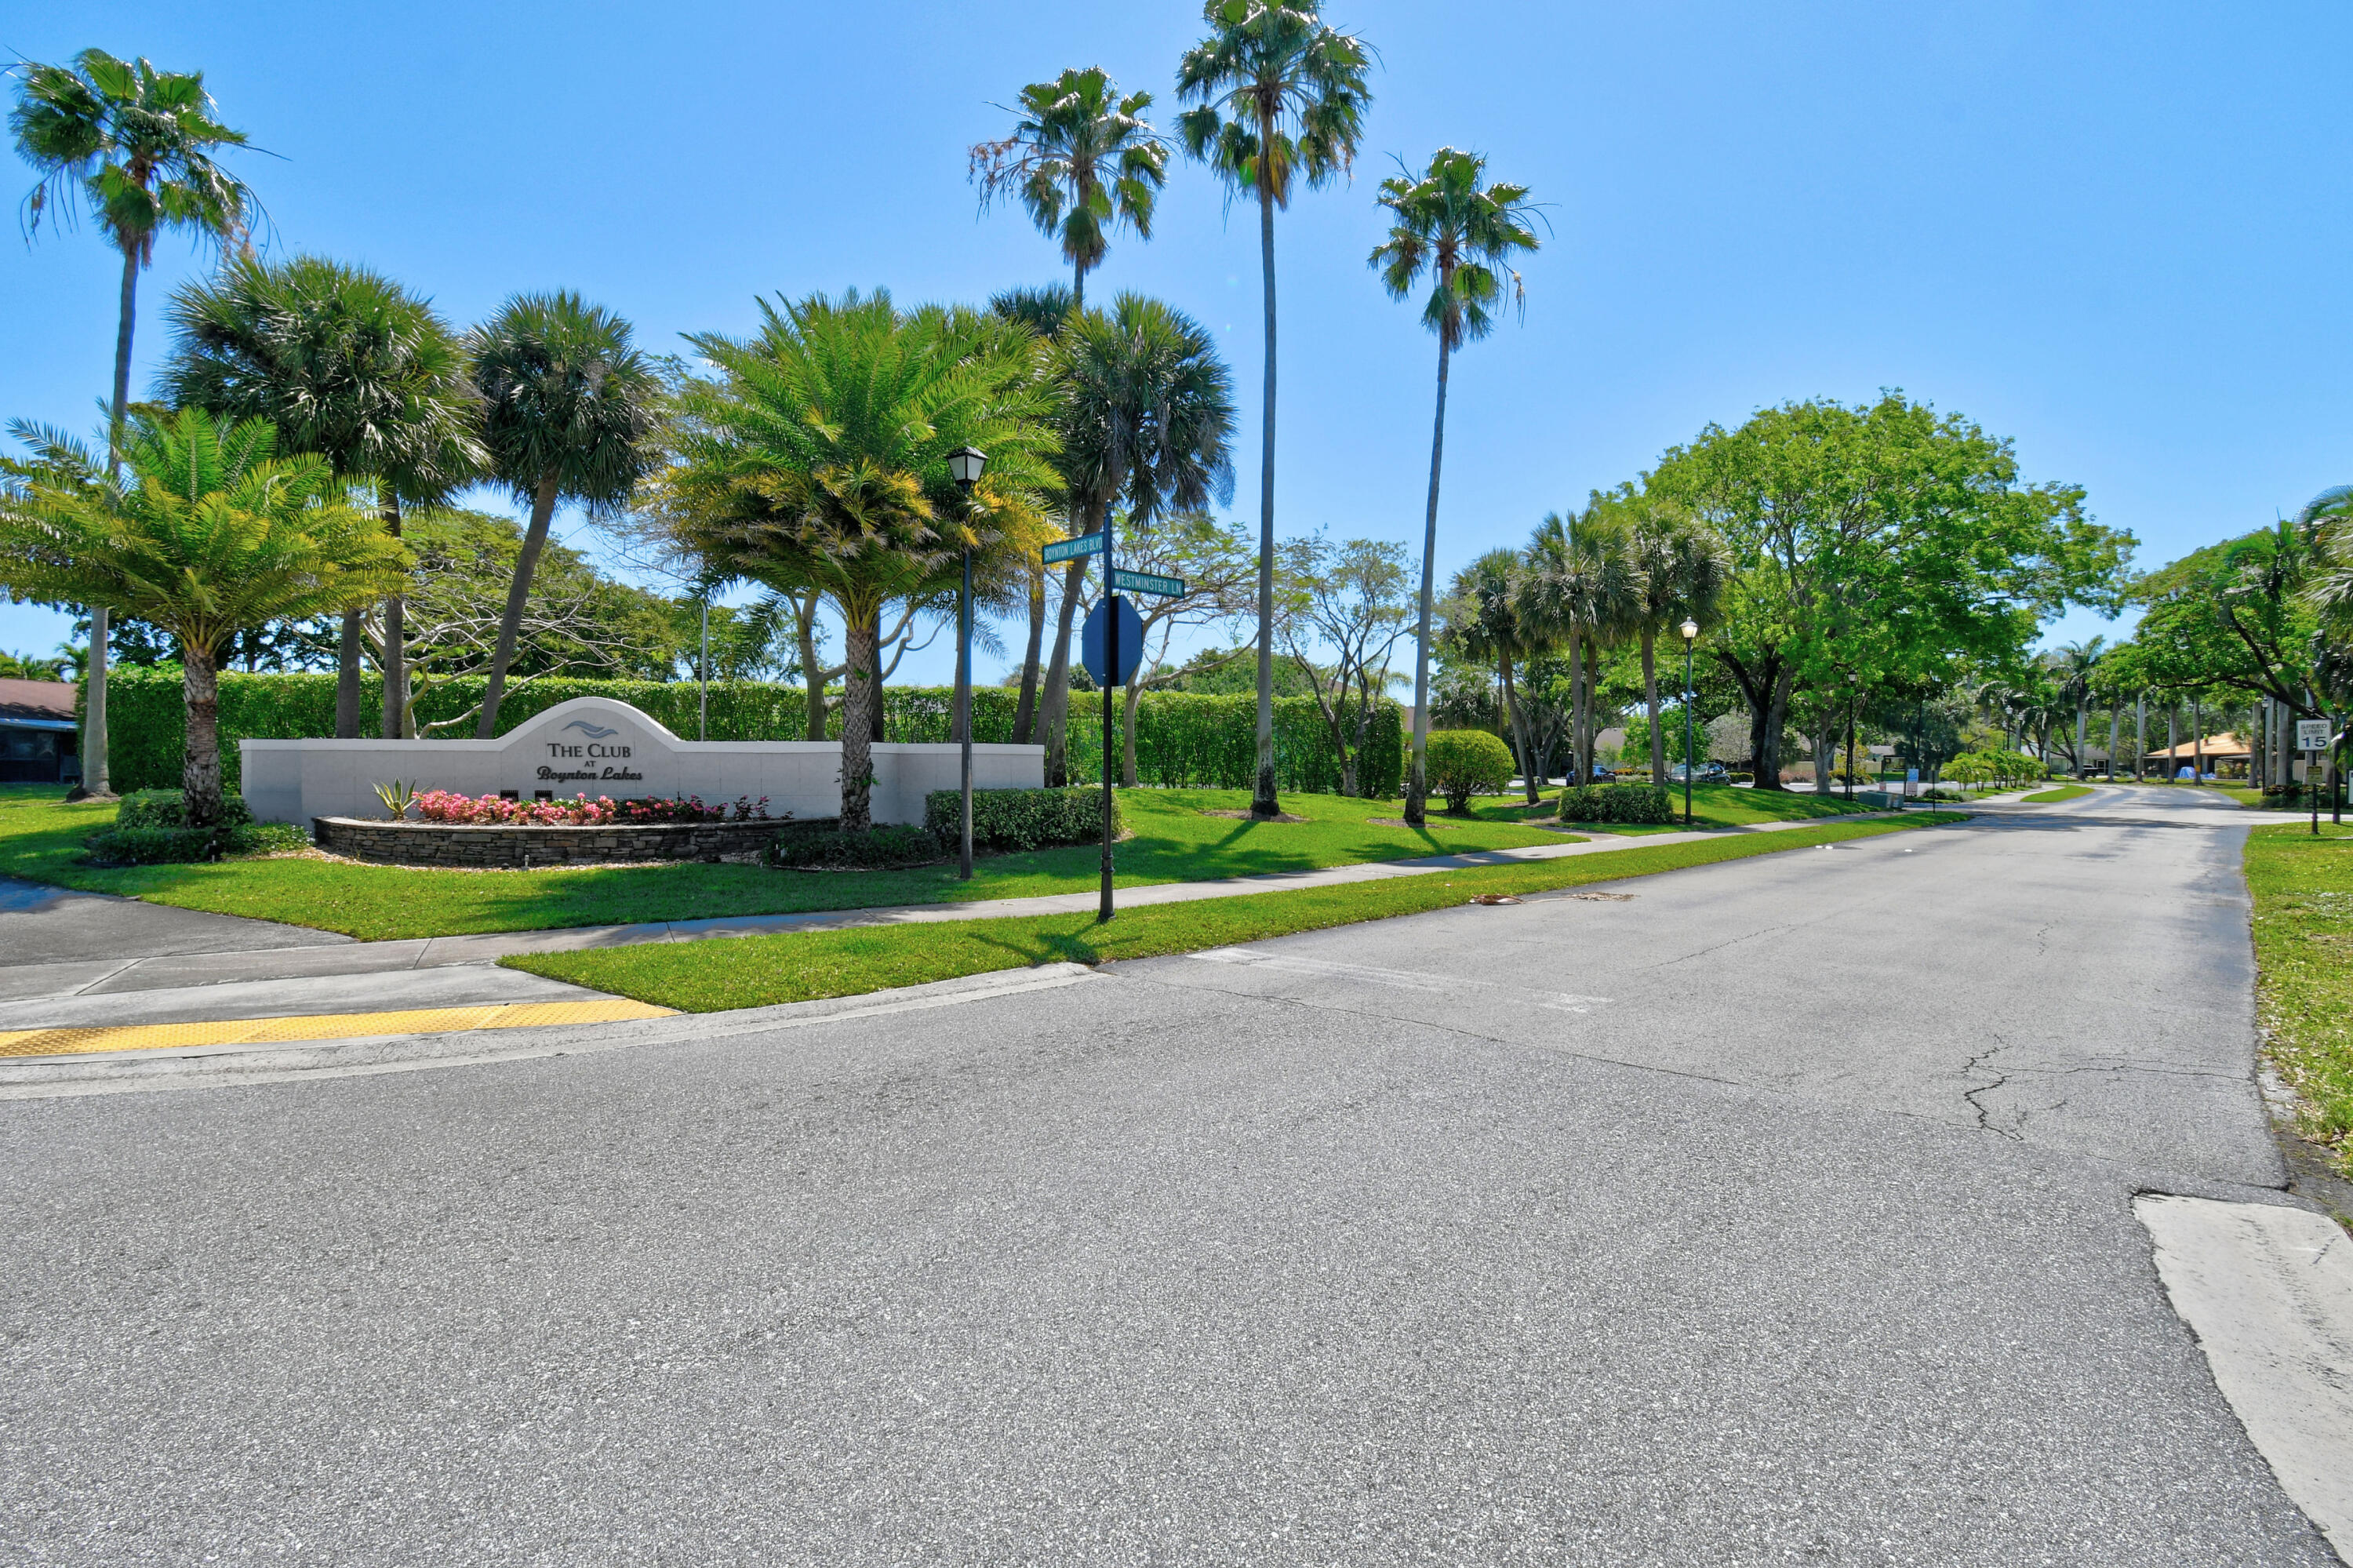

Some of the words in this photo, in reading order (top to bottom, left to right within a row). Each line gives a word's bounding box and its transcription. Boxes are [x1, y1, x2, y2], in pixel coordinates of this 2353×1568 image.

[1045, 544, 1068, 559] BOYNTON
[1070, 542, 1087, 555] LAKES
[1089, 537, 1103, 551] BLVD
[1115, 573, 1168, 593] WESTMINSTER
[1171, 581, 1181, 595] LN
[2302, 736, 2327, 747] 15
[547, 743, 583, 758] THE
[587, 743, 631, 758] CLUB
[536, 766, 598, 783] Boynton
[600, 766, 642, 780] Lakes
